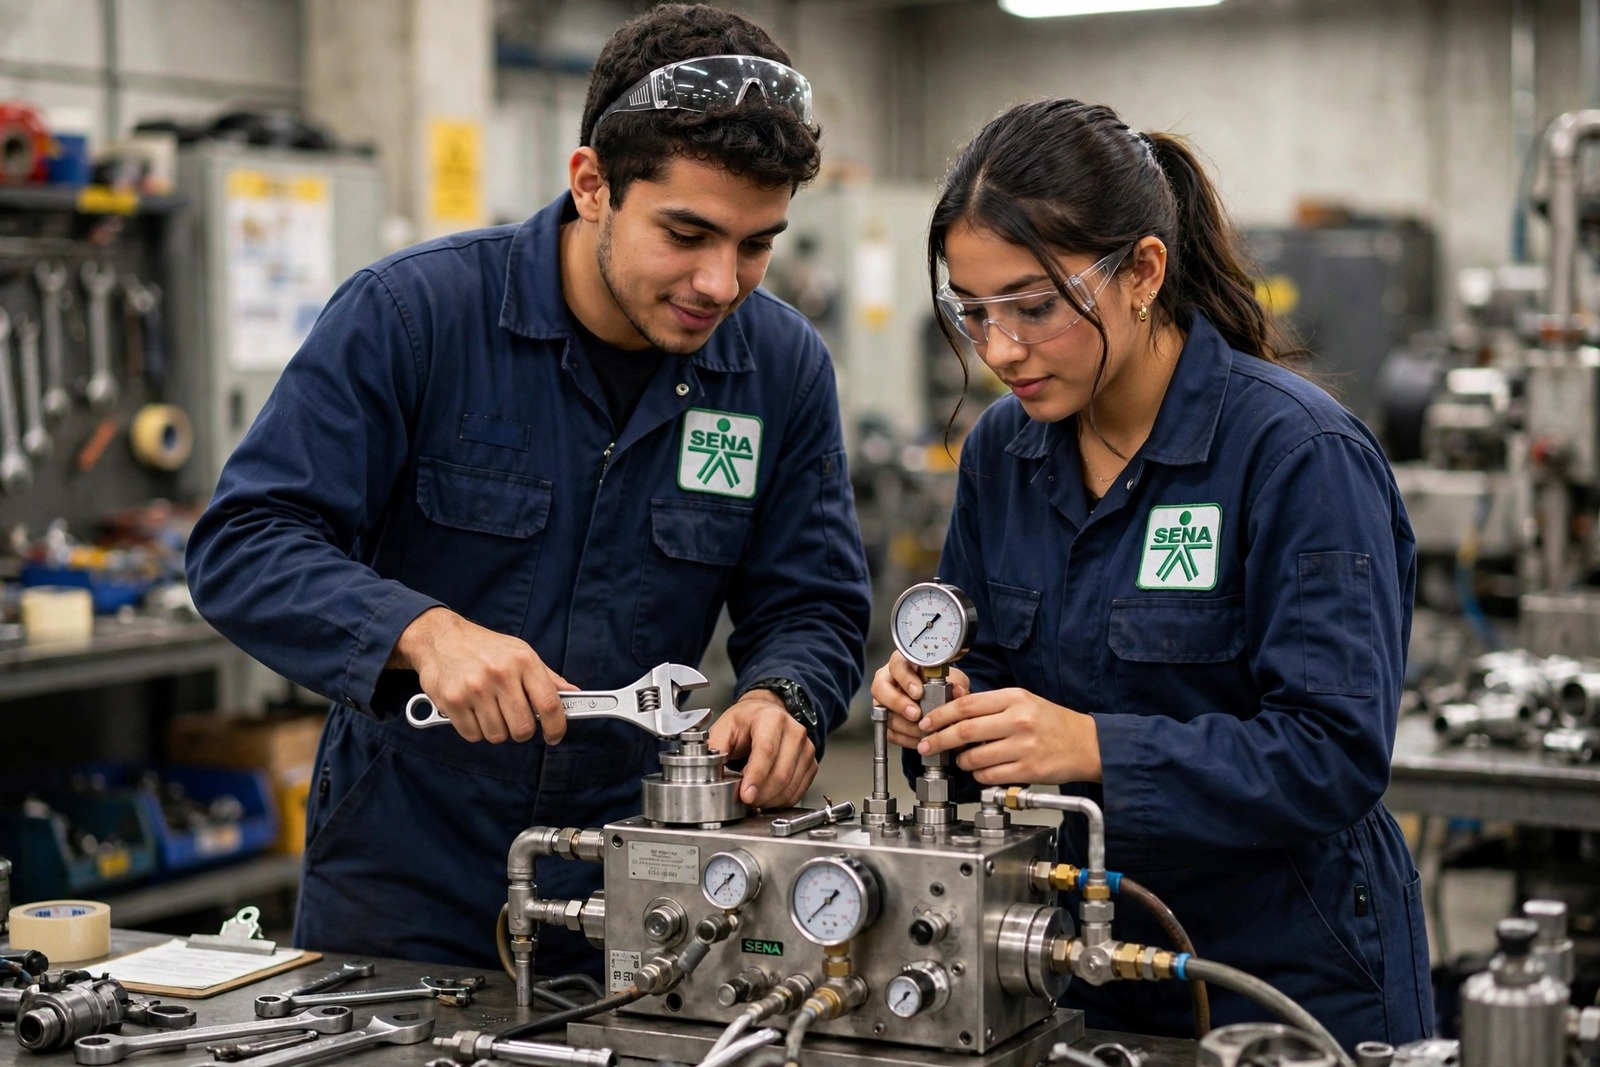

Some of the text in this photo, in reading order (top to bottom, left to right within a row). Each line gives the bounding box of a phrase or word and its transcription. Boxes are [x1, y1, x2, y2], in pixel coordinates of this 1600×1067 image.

[690, 430, 752, 453] SENA
[1153, 526, 1212, 543] SENA
[745, 941, 782, 955] SENA
